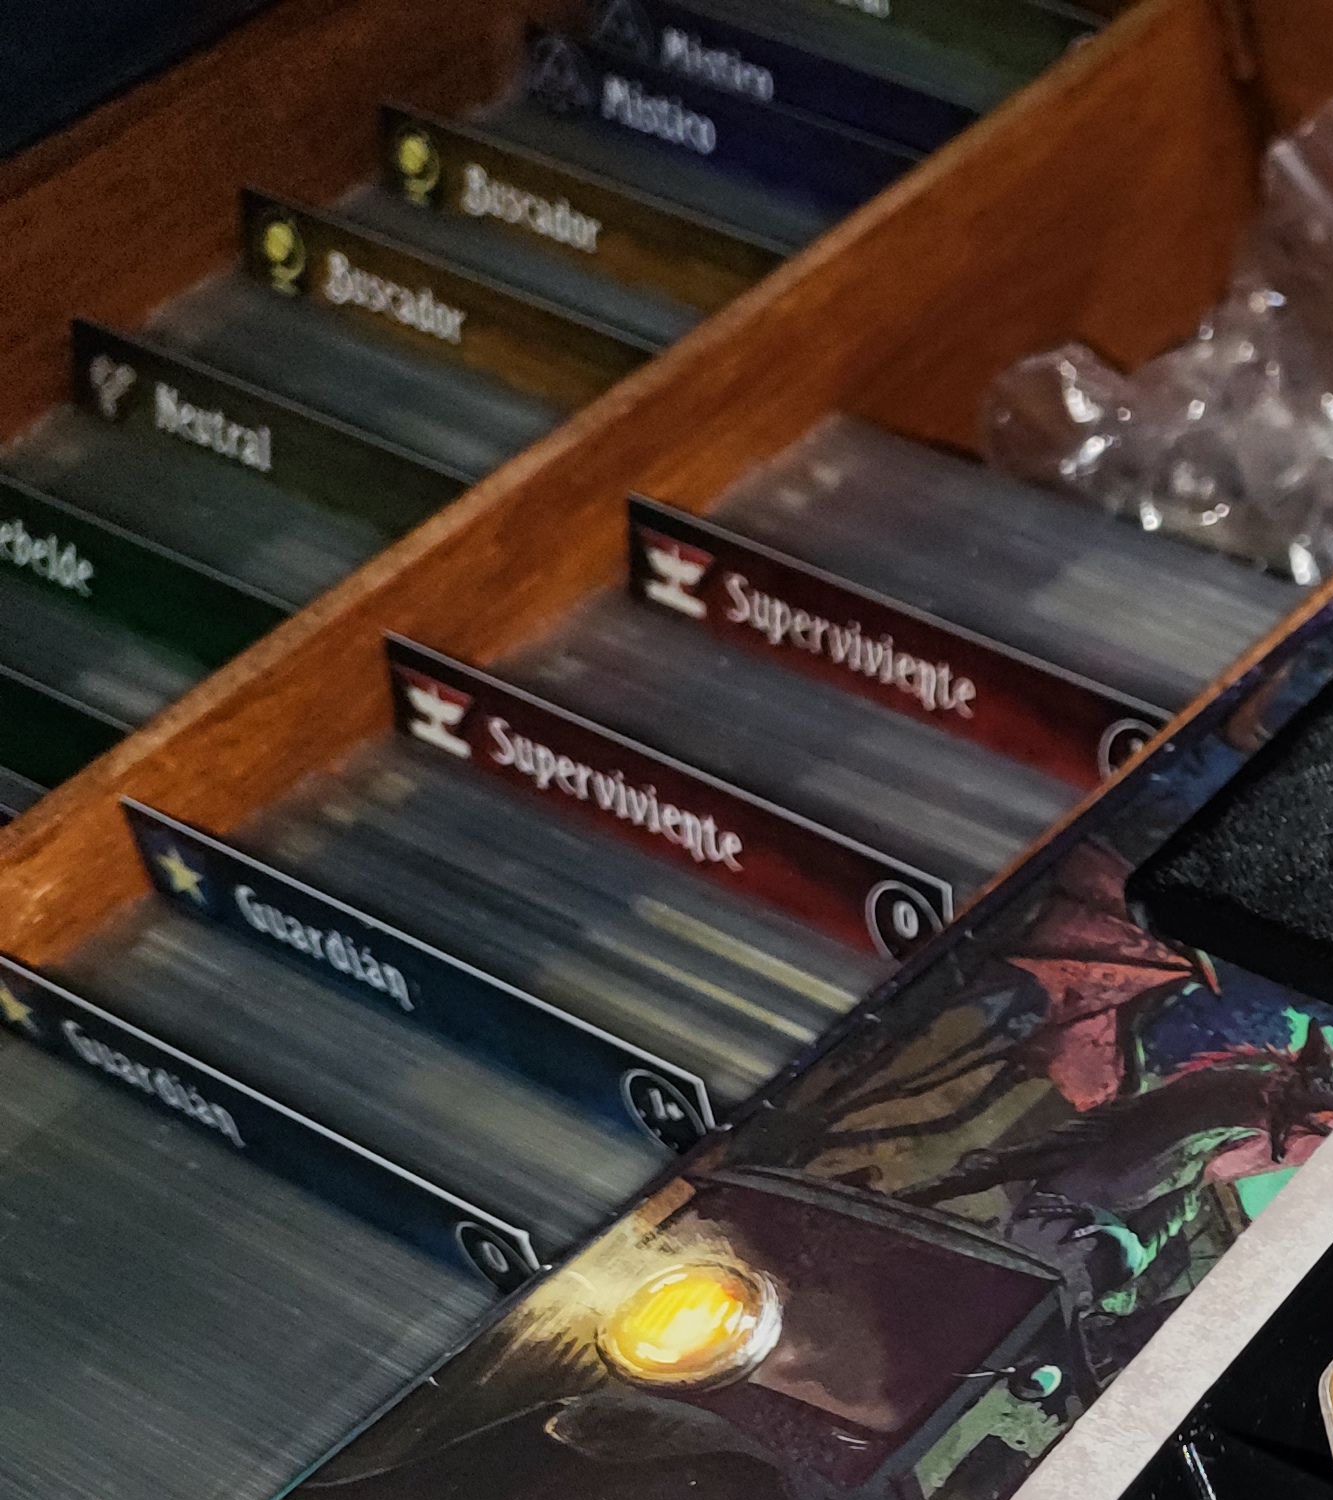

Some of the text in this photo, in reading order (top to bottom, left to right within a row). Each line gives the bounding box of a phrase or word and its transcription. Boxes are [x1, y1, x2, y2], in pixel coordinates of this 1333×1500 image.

[155, 381, 272, 472] Neutral
[0, 518, 94, 598] ebelde
[724, 572, 979, 719] Superviviente
[486, 714, 744, 873] Superviviente
